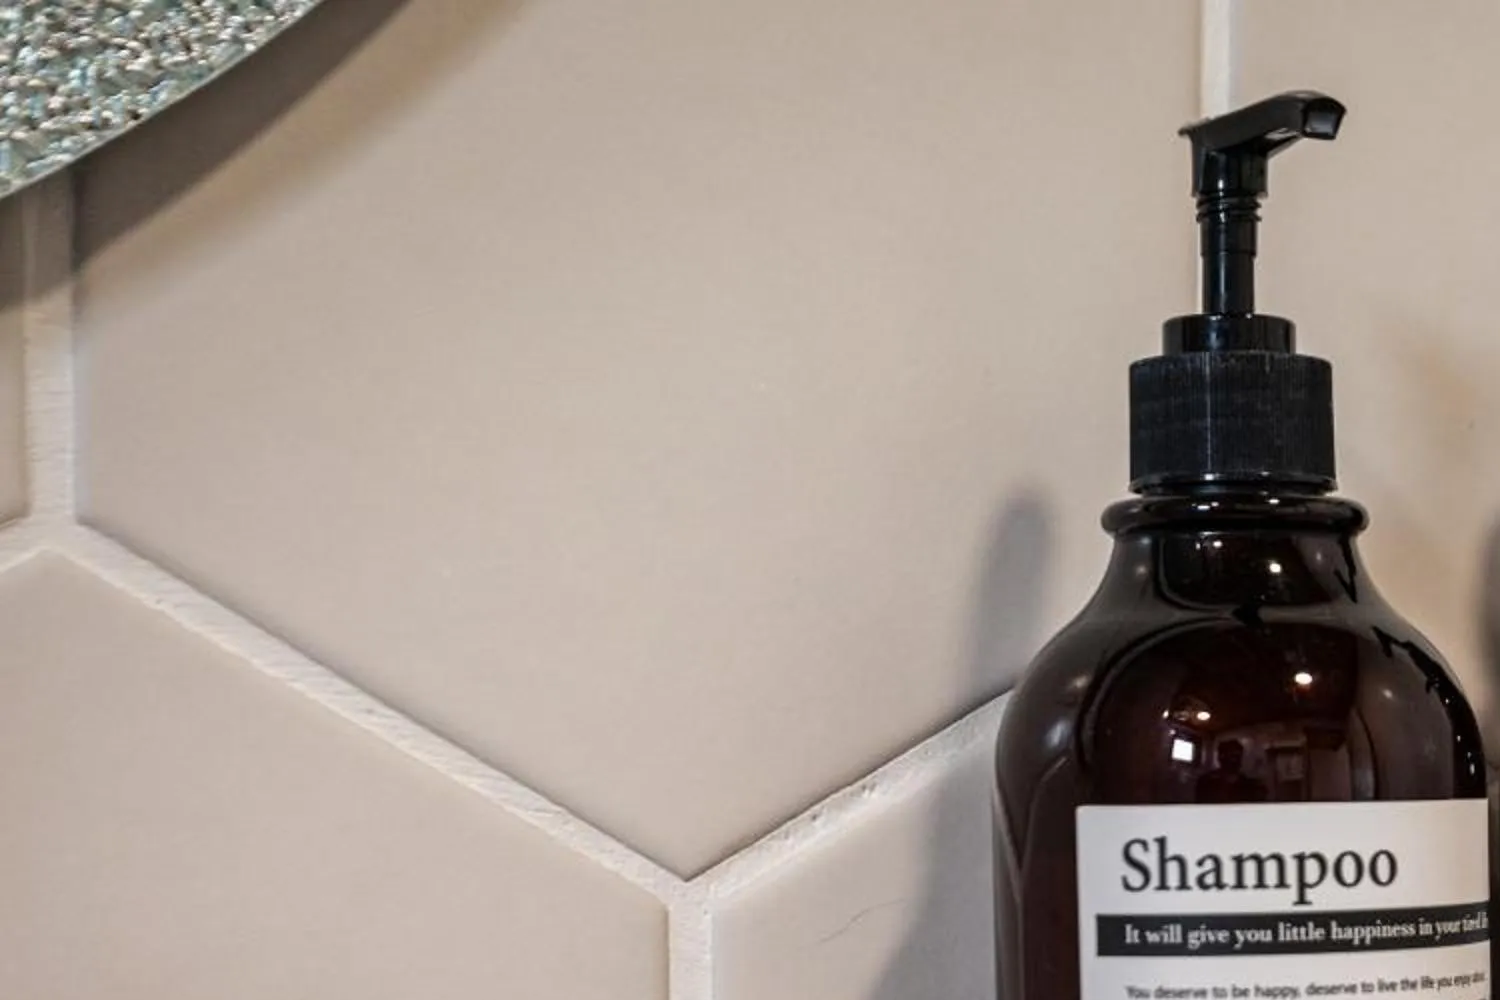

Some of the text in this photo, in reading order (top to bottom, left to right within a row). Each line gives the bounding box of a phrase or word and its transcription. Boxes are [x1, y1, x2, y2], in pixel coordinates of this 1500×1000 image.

[1121, 835, 1398, 906] Shampoo
[1125, 924, 1140, 944] It
[1144, 924, 1183, 943] will
[1187, 924, 1230, 949] give
[1234, 929, 1273, 949] you
[1278, 921, 1326, 941] little
[1330, 919, 1416, 946] happiness
[1419, 917, 1434, 936] in
[1435, 919, 1460, 939] your
[1125, 978, 1418, 1000] You deserve to be deserve to live the
